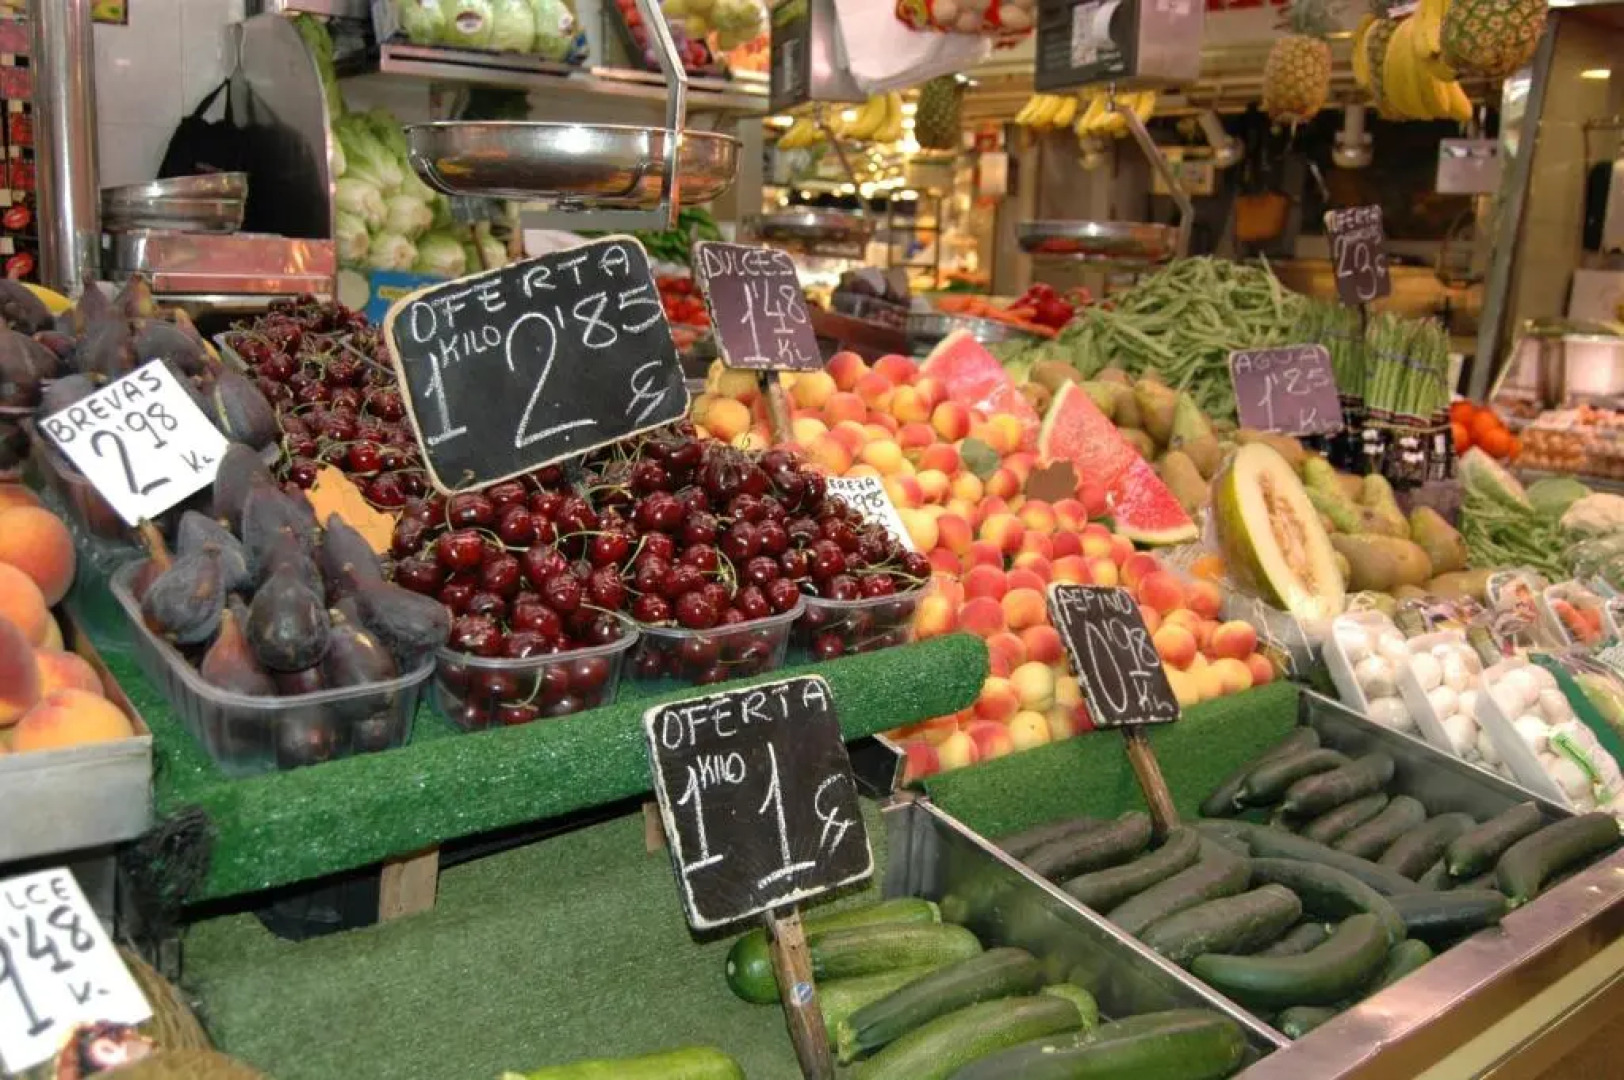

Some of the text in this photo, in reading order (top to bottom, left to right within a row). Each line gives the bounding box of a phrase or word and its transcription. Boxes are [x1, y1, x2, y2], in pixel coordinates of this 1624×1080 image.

[411, 245, 630, 342] OFERTA
[702, 247, 794, 279] DULCES
[740, 279, 806, 362] 1'48
[439, 326, 501, 368] KILO
[504, 285, 664, 449] 2'85
[46, 370, 162, 443] BREVAS
[90, 402, 178, 496] 2'98
[828, 476, 875, 492] EREZA
[1058, 586, 1133, 625] PEPINO
[662, 680, 828, 750] OFERTA
[5, 876, 71, 910] LCE
